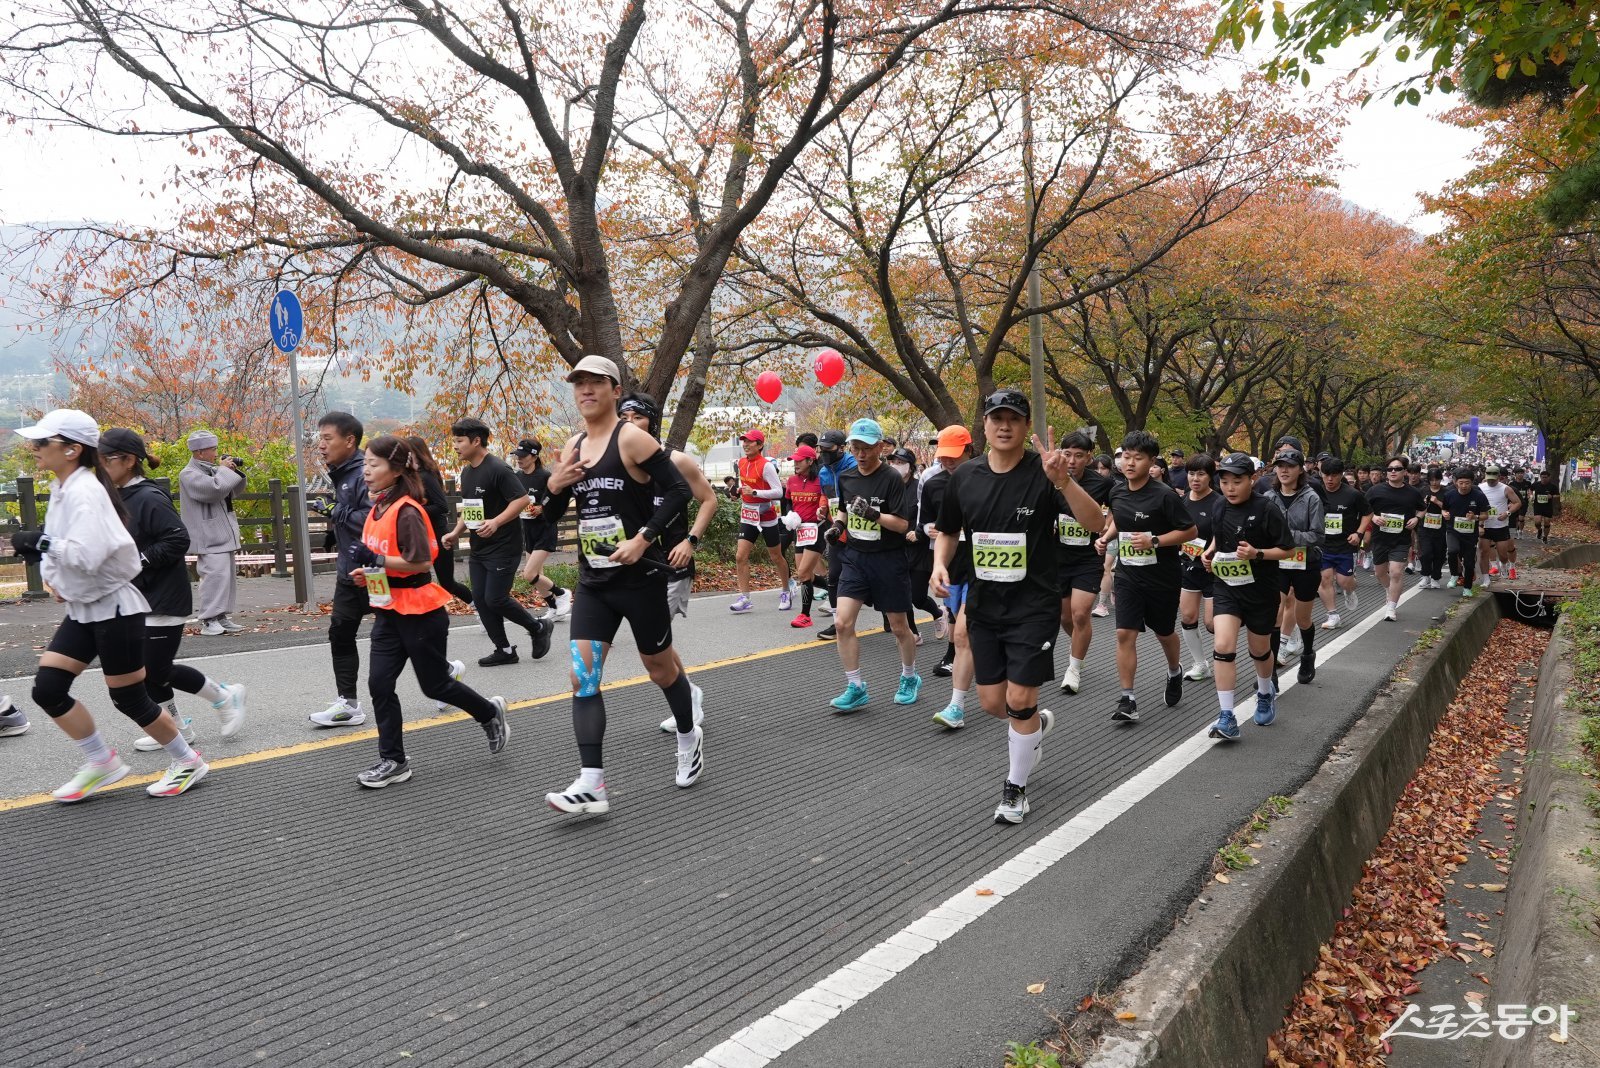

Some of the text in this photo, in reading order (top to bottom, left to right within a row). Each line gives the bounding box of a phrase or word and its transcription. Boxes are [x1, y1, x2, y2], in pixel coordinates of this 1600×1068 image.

[464, 510, 483, 521] 1356
[849, 517, 878, 531] 1372
[1060, 525, 1090, 538] 1858
[976, 550, 1023, 568] 2222
[1213, 563, 1249, 577] 1033
